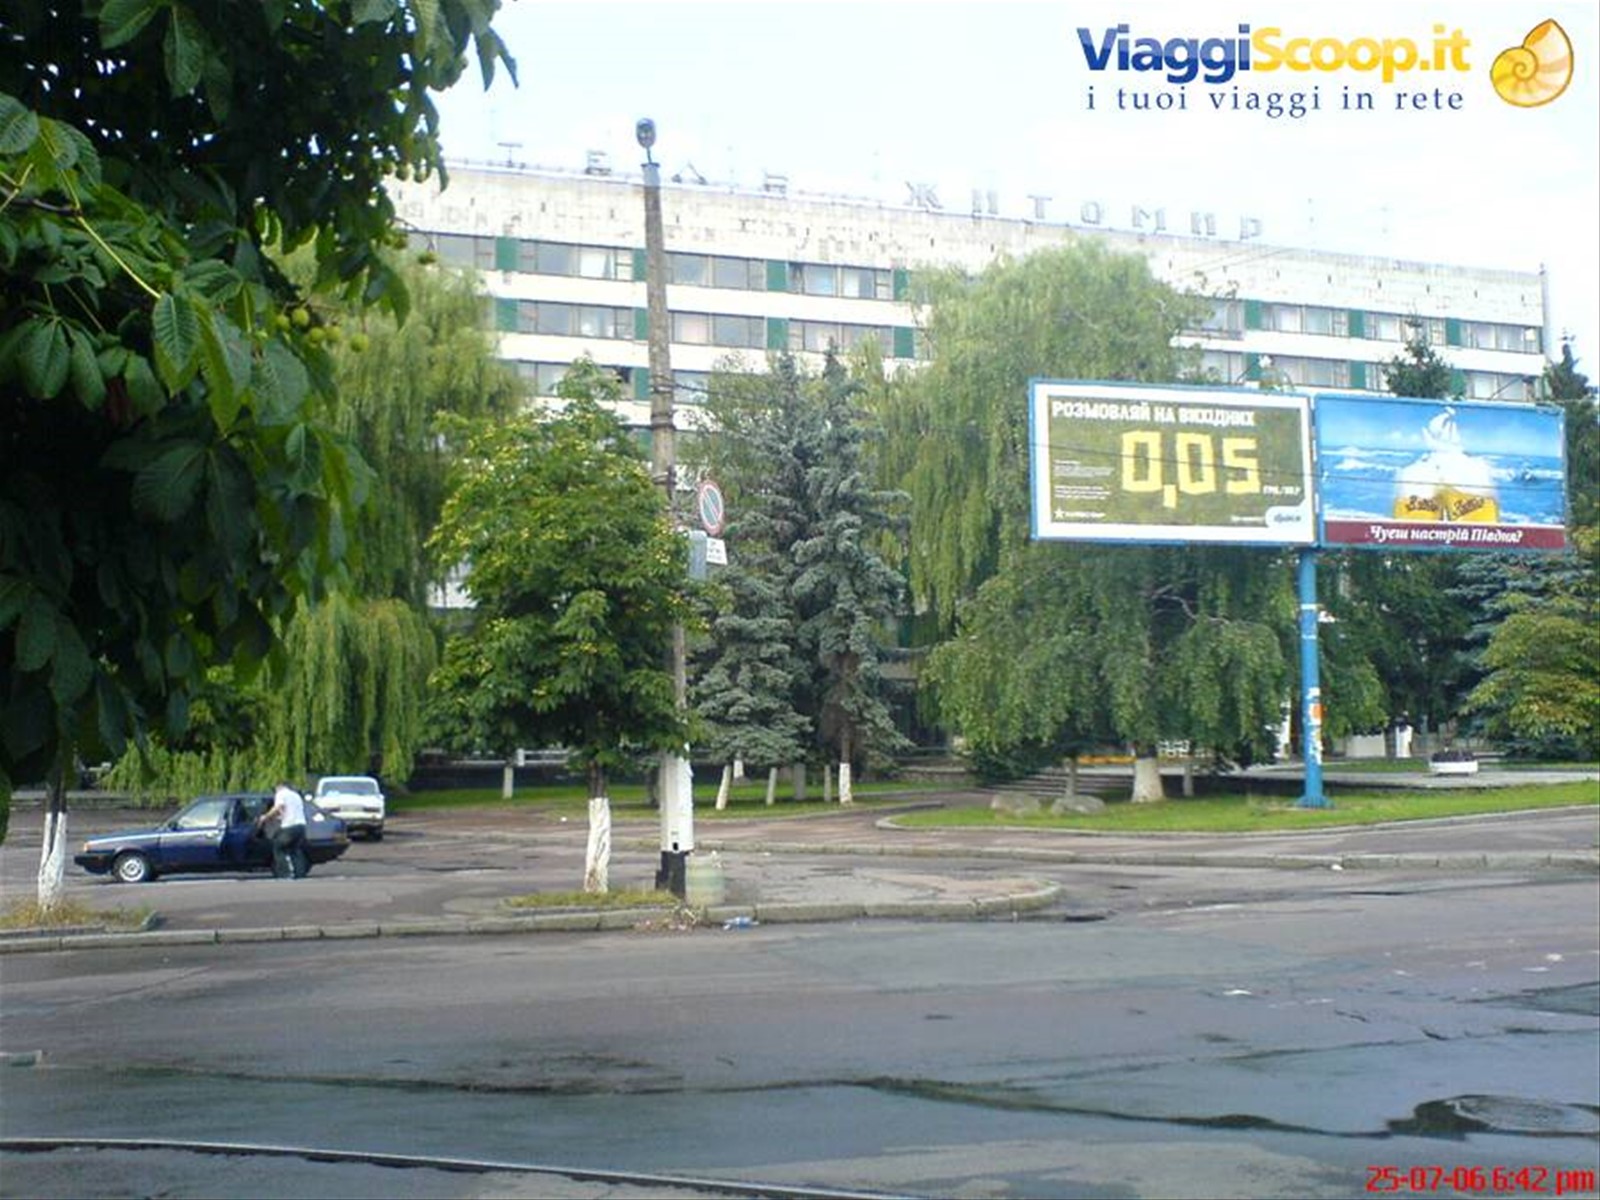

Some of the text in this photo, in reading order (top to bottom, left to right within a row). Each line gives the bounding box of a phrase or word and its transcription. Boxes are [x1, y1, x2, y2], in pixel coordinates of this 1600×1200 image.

[904, 180, 1264, 241] ЖИТОМИР
[1052, 401, 1151, 421] РОЗМОВЛЯЙ
[1154, 405, 1176, 423] НА
[1121, 430, 1262, 509] 0,05
[1410, 528, 1469, 544] настрій
